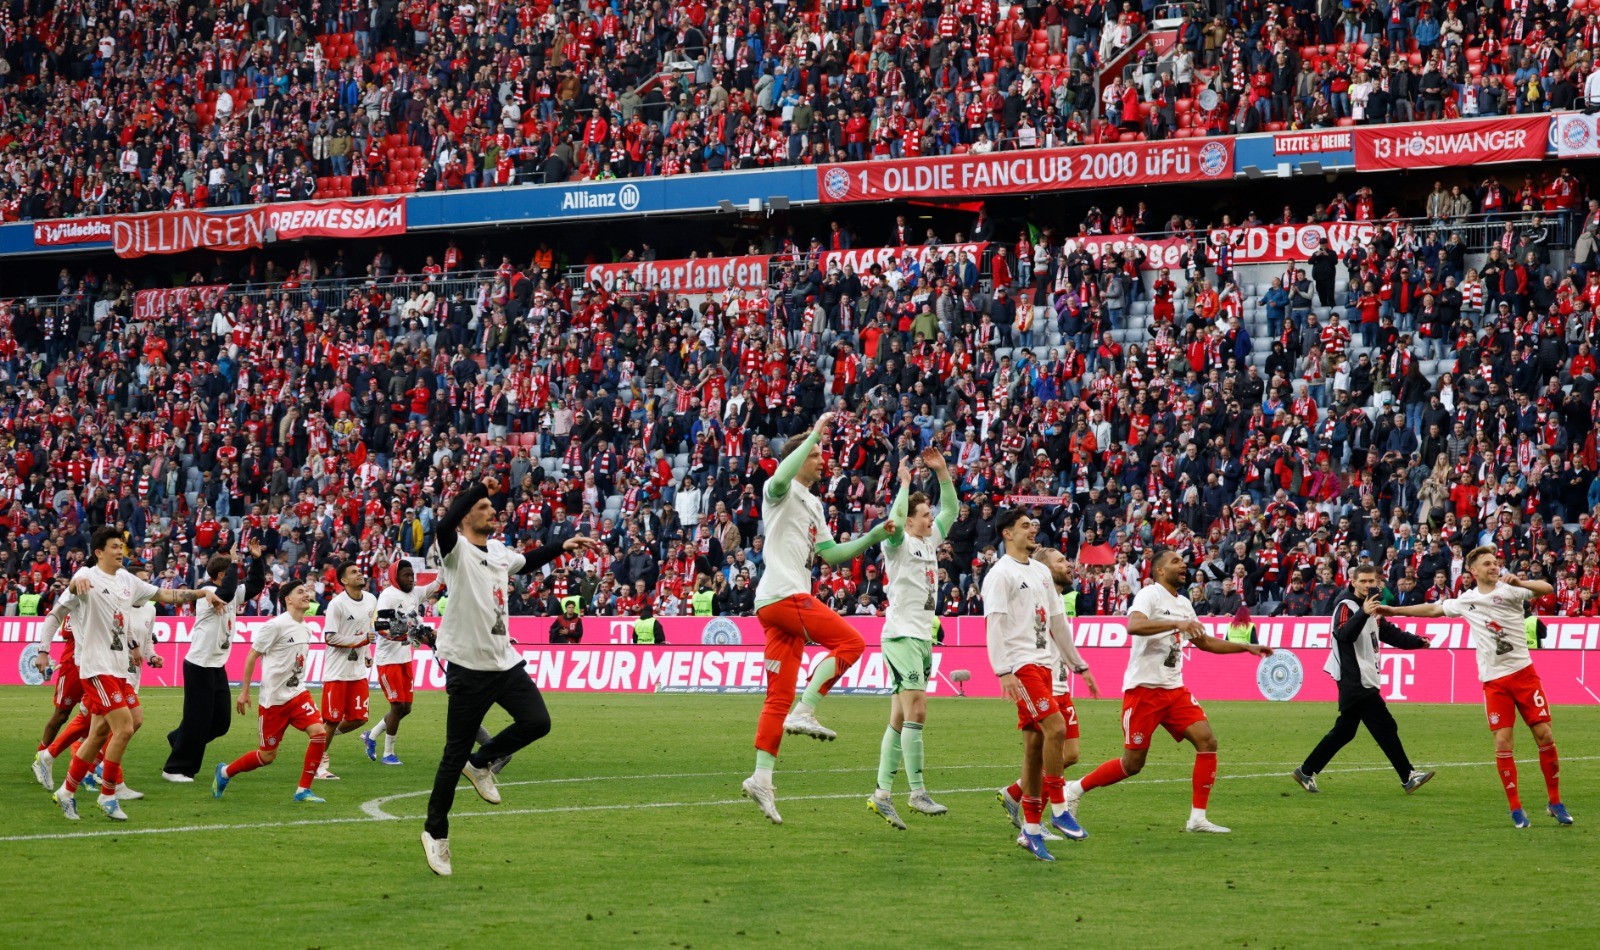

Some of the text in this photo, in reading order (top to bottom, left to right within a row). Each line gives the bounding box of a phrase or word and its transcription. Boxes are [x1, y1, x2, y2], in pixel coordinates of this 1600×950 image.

[1275, 133, 1351, 152] LETZTE REIHE
[1373, 129, 1527, 158] 13 HÖSLWANGER
[858, 147, 1191, 194] 1. OLDIE FANCLUB 2000 üFü
[563, 190, 616, 210] Allianz
[270, 204, 402, 231] OBERKESSACH
[114, 211, 264, 253] DILLINGEN
[1275, 223, 1393, 257] POWE
[566, 651, 636, 689] ZUR
[1380, 653, 1415, 700] T
[302, 702, 318, 716] 3
[355, 696, 369, 711] 14
[1533, 690, 1544, 707] 6
